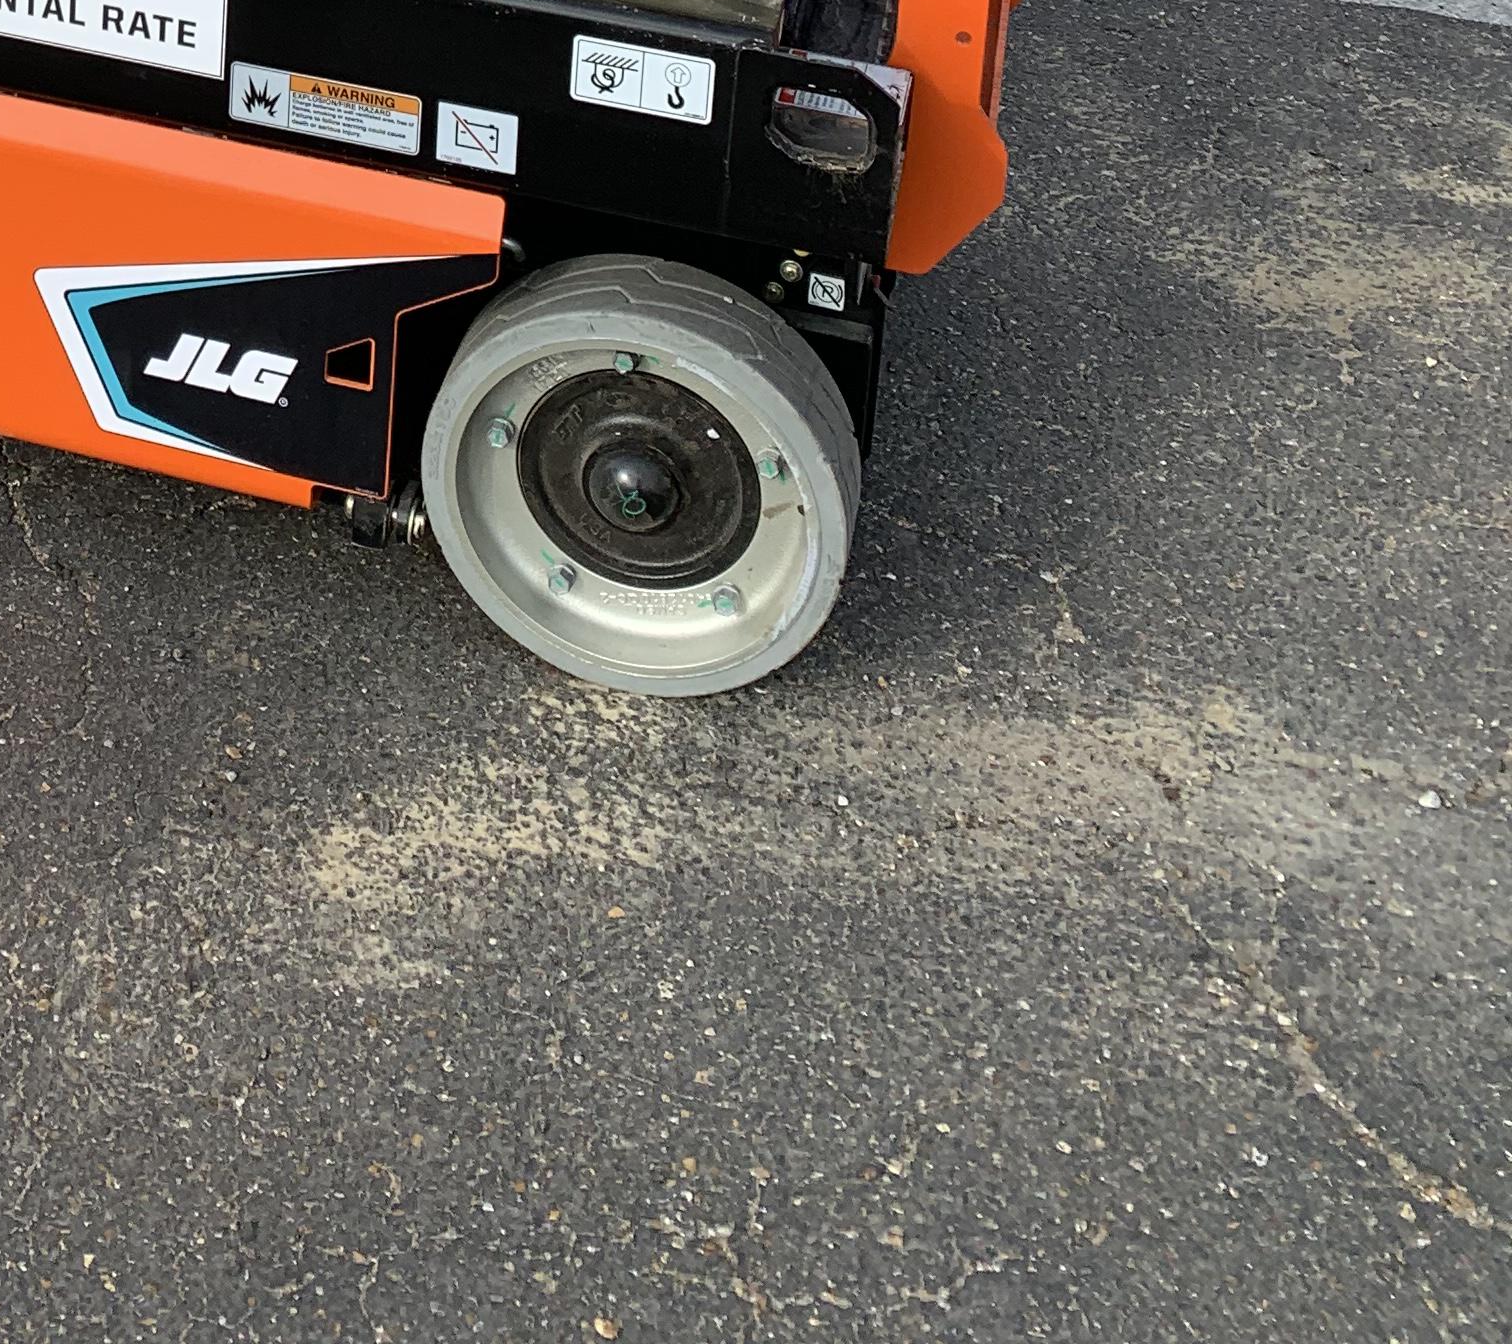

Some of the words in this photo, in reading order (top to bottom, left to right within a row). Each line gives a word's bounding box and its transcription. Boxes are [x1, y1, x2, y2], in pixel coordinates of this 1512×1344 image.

[101, 4, 198, 49] RATE
[327, 85, 395, 108] WARNING
[143, 332, 299, 405] JLG
